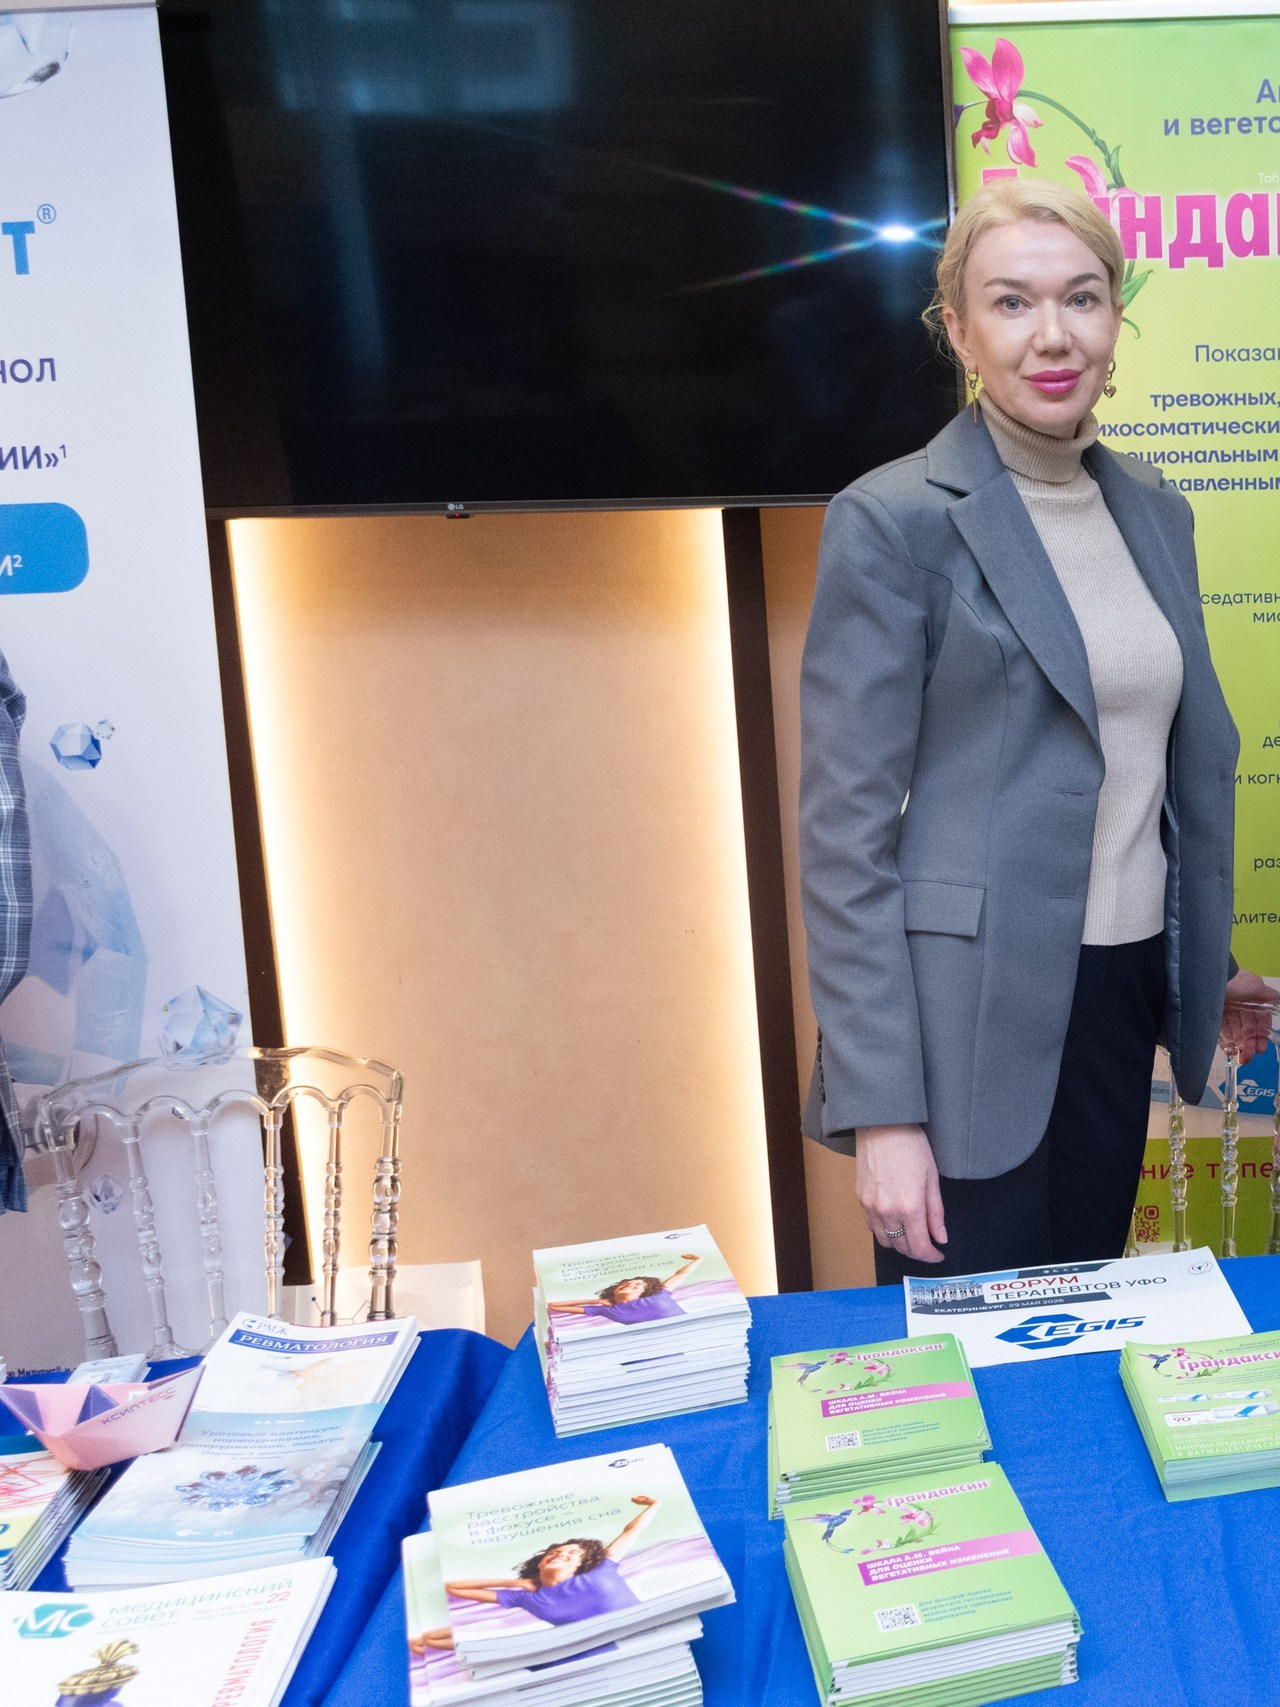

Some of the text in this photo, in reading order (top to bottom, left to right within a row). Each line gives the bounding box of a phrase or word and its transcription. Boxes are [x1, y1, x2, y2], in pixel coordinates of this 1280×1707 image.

[1163, 115, 1180, 137] и
[990, 1275, 1079, 1292] ФОРУМ
[991, 1276, 1168, 1301] ТЕРАПЕВТОВ УФО
[256, 1321, 289, 1336] РМЖ
[1044, 1315, 1147, 1338] EGIS
[240, 1333, 388, 1351] РЕВМАТОЛОГИЯ
[855, 1342, 943, 1362] Грандаксин
[1173, 1415, 1191, 1423] 90
[886, 1479, 989, 1508] Грандаксин
[465, 1490, 575, 1519] Тревожные
[470, 1507, 621, 1546] нарушения сна
[485, 1514, 555, 1537] фокусе
[866, 1555, 903, 1570] ШКАЛА
[868, 1565, 891, 1577] ДЛЯ
[266, 1590, 292, 1604] 22
